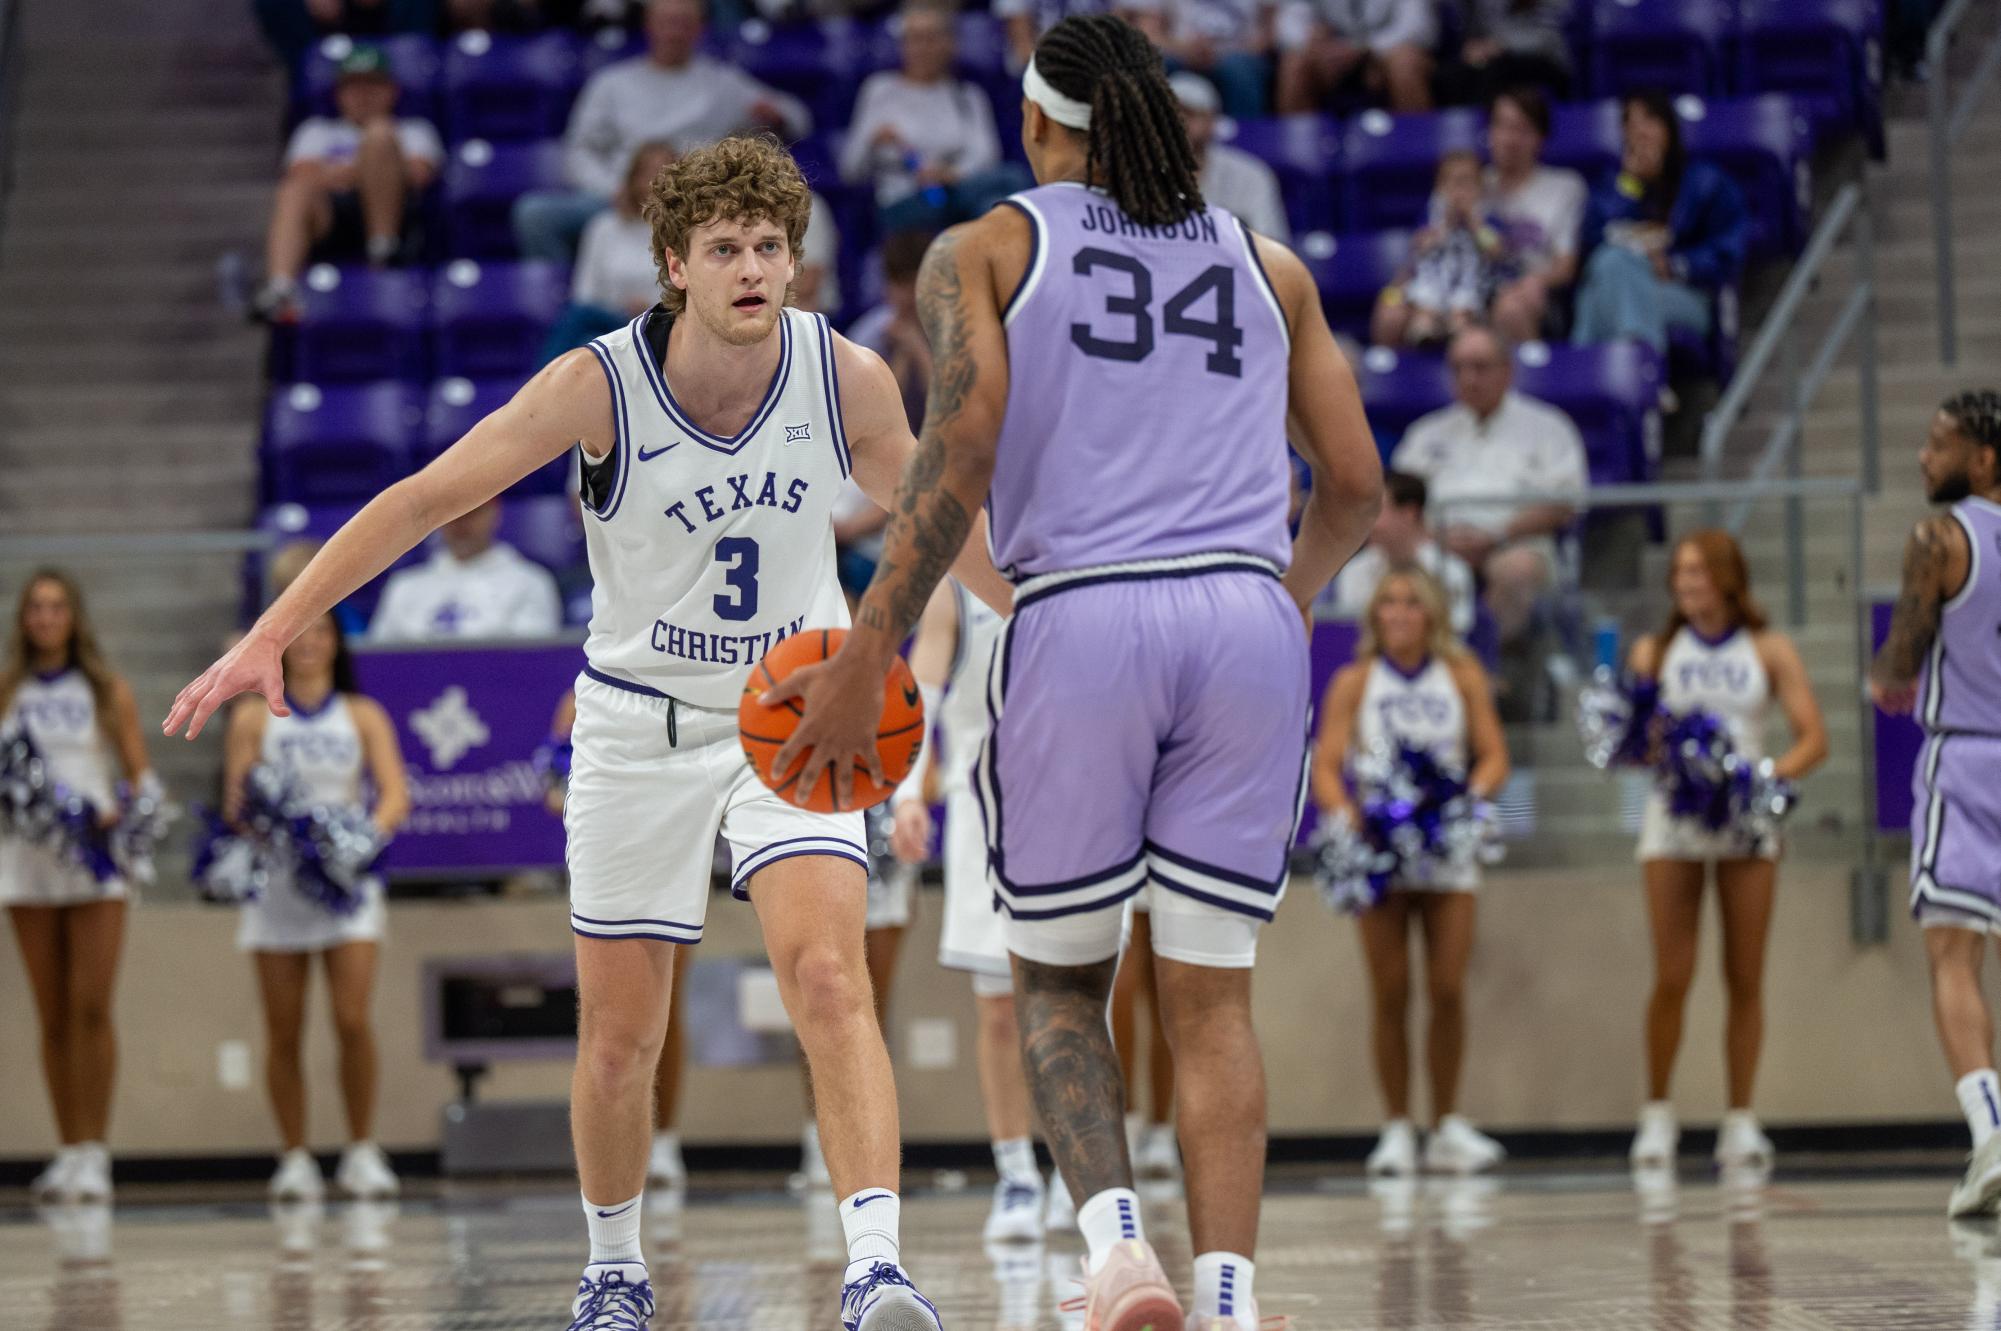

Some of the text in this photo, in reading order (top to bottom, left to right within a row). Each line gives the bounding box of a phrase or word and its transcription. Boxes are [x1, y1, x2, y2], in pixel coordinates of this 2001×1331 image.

[1070, 246, 1243, 378] 34
[664, 472, 808, 533] TEXAS
[713, 536, 759, 621] 3
